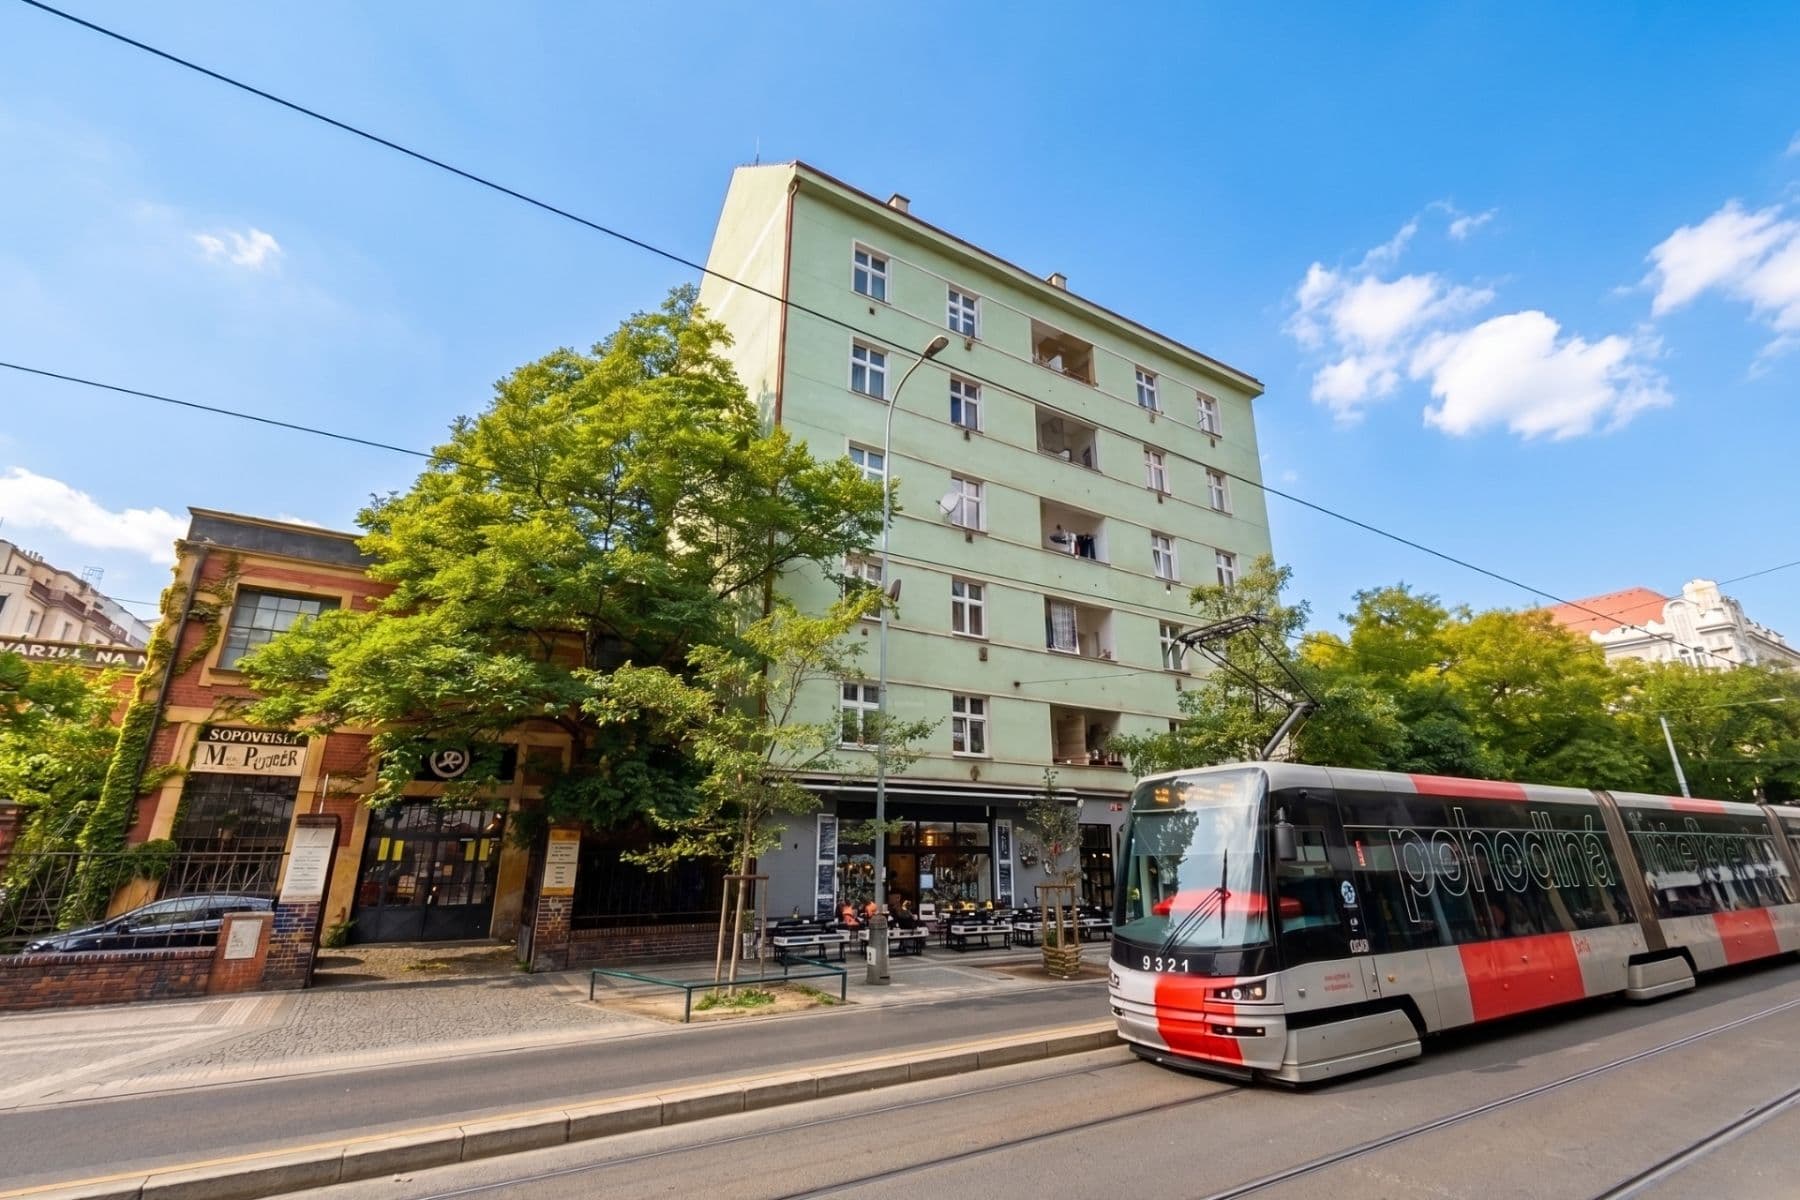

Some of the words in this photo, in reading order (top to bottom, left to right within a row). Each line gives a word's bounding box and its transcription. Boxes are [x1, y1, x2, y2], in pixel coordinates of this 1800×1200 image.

[95, 651, 126, 664] NA
[1388, 807, 1617, 923] pohodlná
[1142, 955, 1189, 973] 9321
